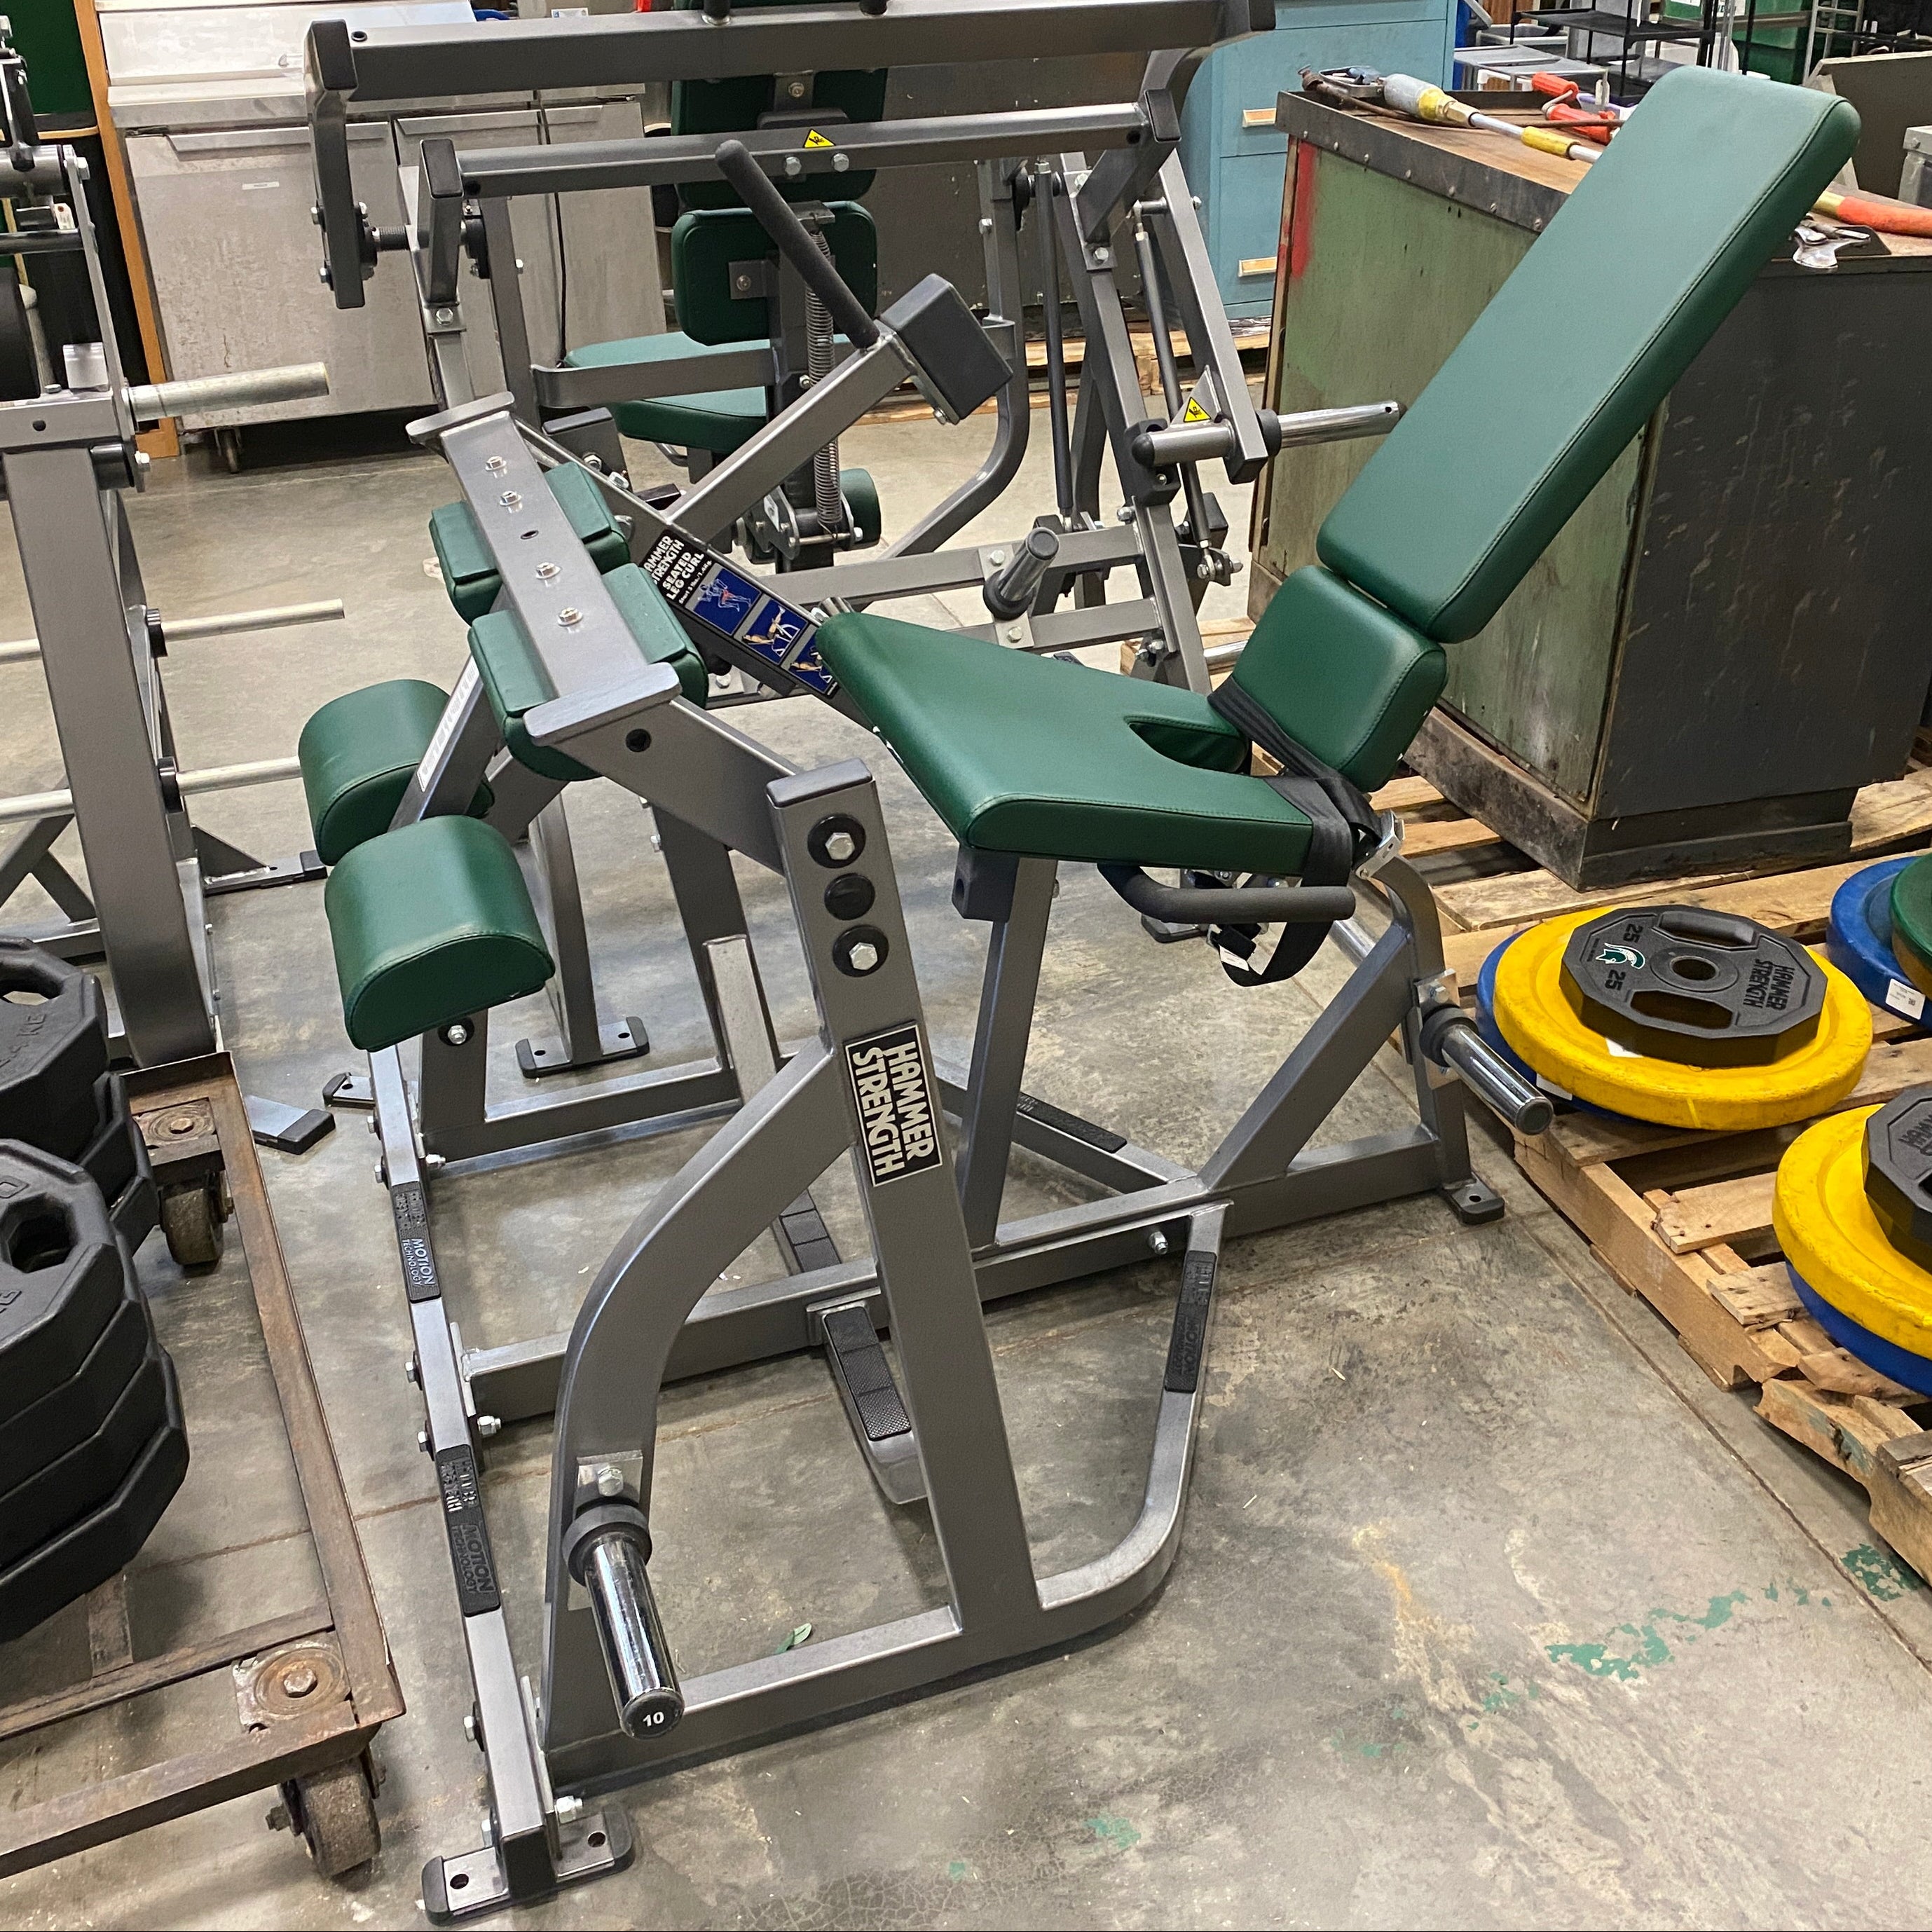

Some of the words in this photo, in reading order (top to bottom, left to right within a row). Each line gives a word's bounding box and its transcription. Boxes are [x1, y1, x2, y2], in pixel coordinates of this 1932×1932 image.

[643, 535, 673, 572] AMMER
[662, 552, 692, 590] SEATED
[666, 579, 685, 600] LEG
[681, 554, 704, 579] CURL
[1623, 924, 1643, 943] 25
[1605, 970, 1626, 991] 25
[1743, 959, 1773, 1008] STRENGTH
[1766, 964, 1795, 1010] HAMMER
[852, 1047, 905, 1176] STRENGTH
[884, 1041, 934, 1160] HAMMER
[402, 1239, 423, 1285] TECHNOLOGY
[411, 1238, 435, 1285] MOTION
[451, 1526, 478, 1592] TECHNOLOGY
[463, 1525, 495, 1591] MOTION
[643, 1712, 664, 1727] 10
